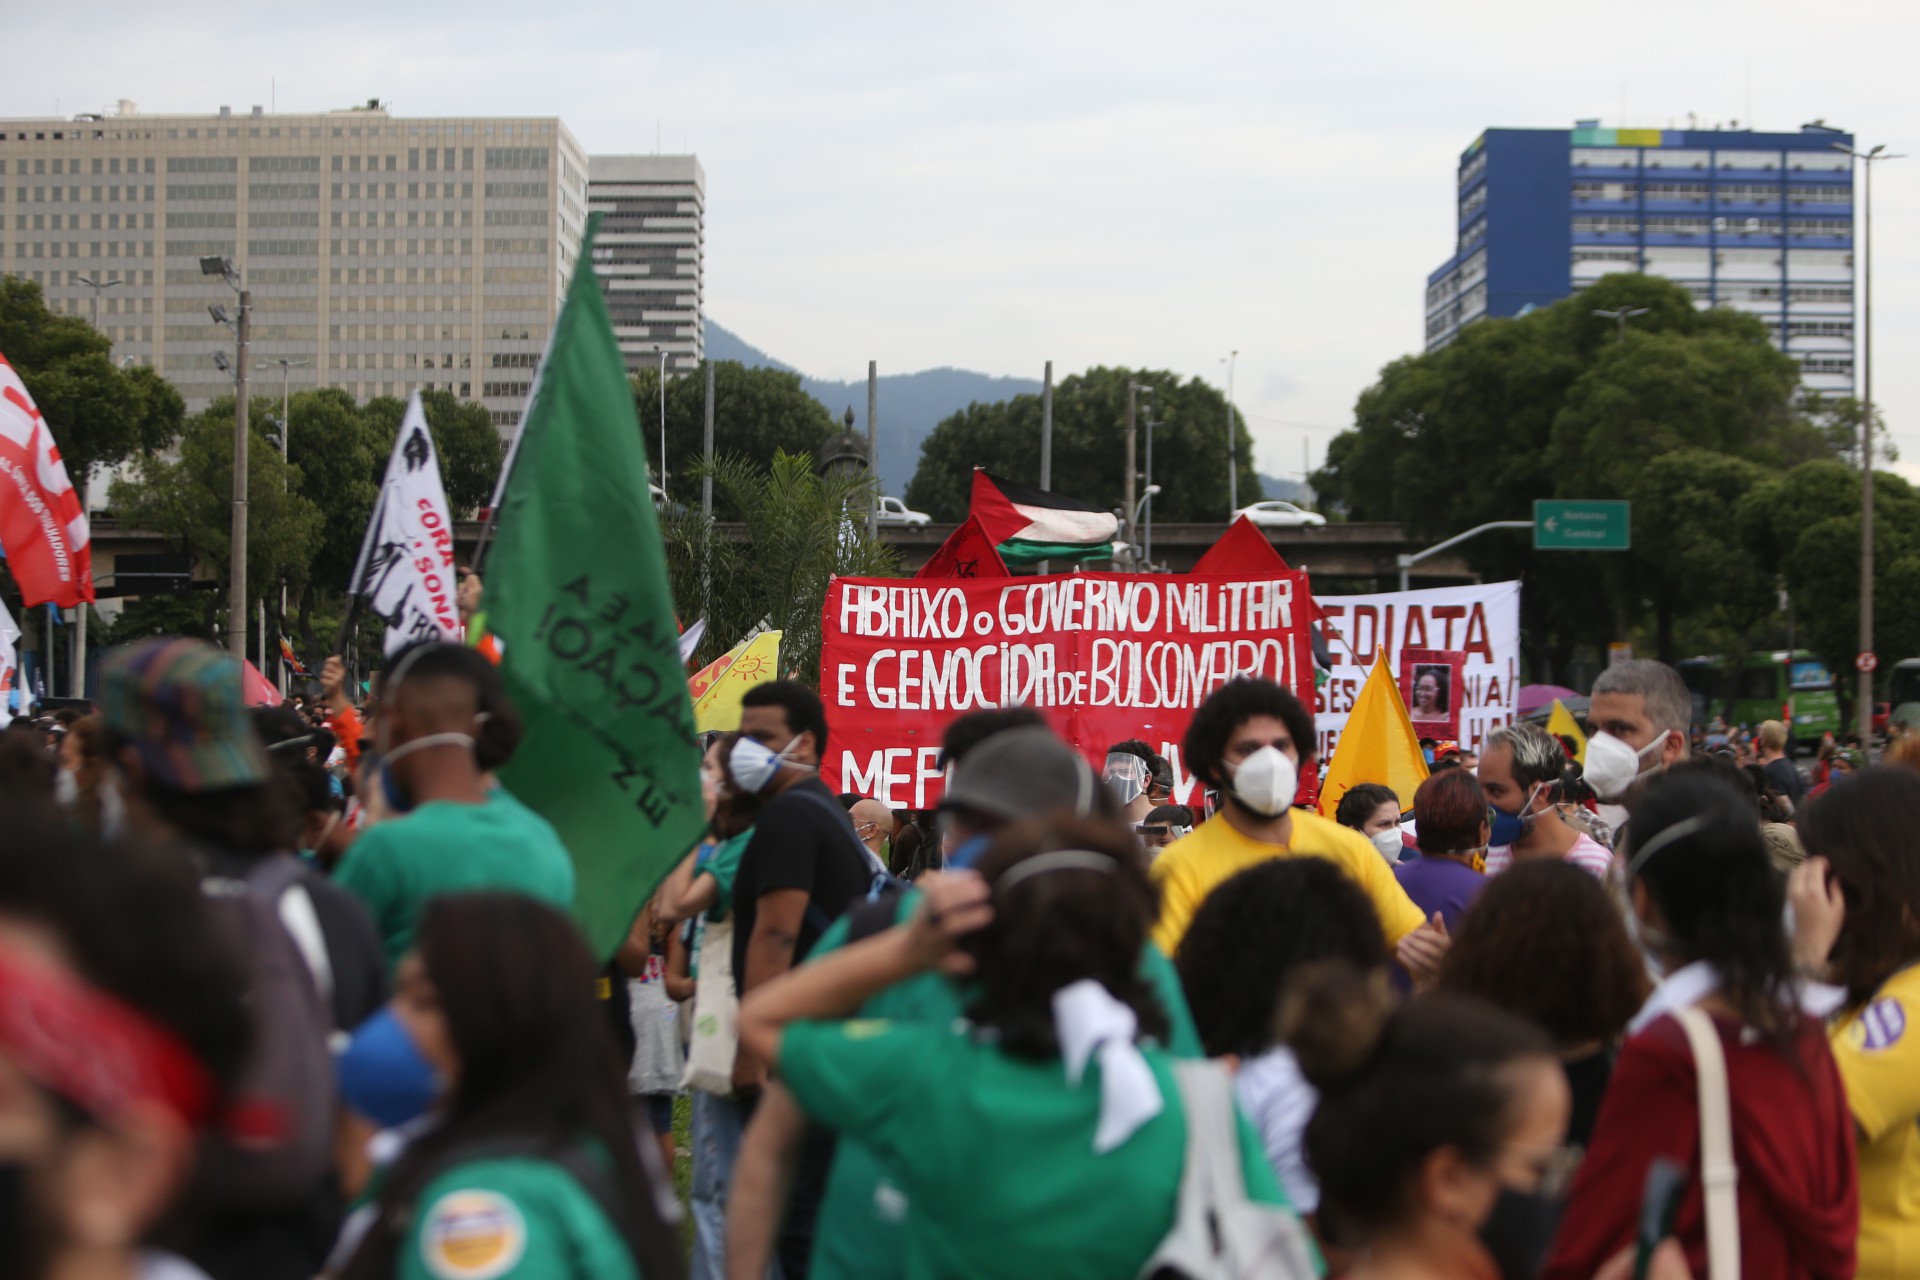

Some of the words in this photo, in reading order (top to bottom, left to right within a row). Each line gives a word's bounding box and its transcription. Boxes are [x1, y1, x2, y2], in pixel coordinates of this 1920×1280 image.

[998, 579, 1159, 636] GOVERNO
[838, 663, 856, 707] E
[1058, 670, 1087, 706] DE
[842, 747, 955, 809] MEP
